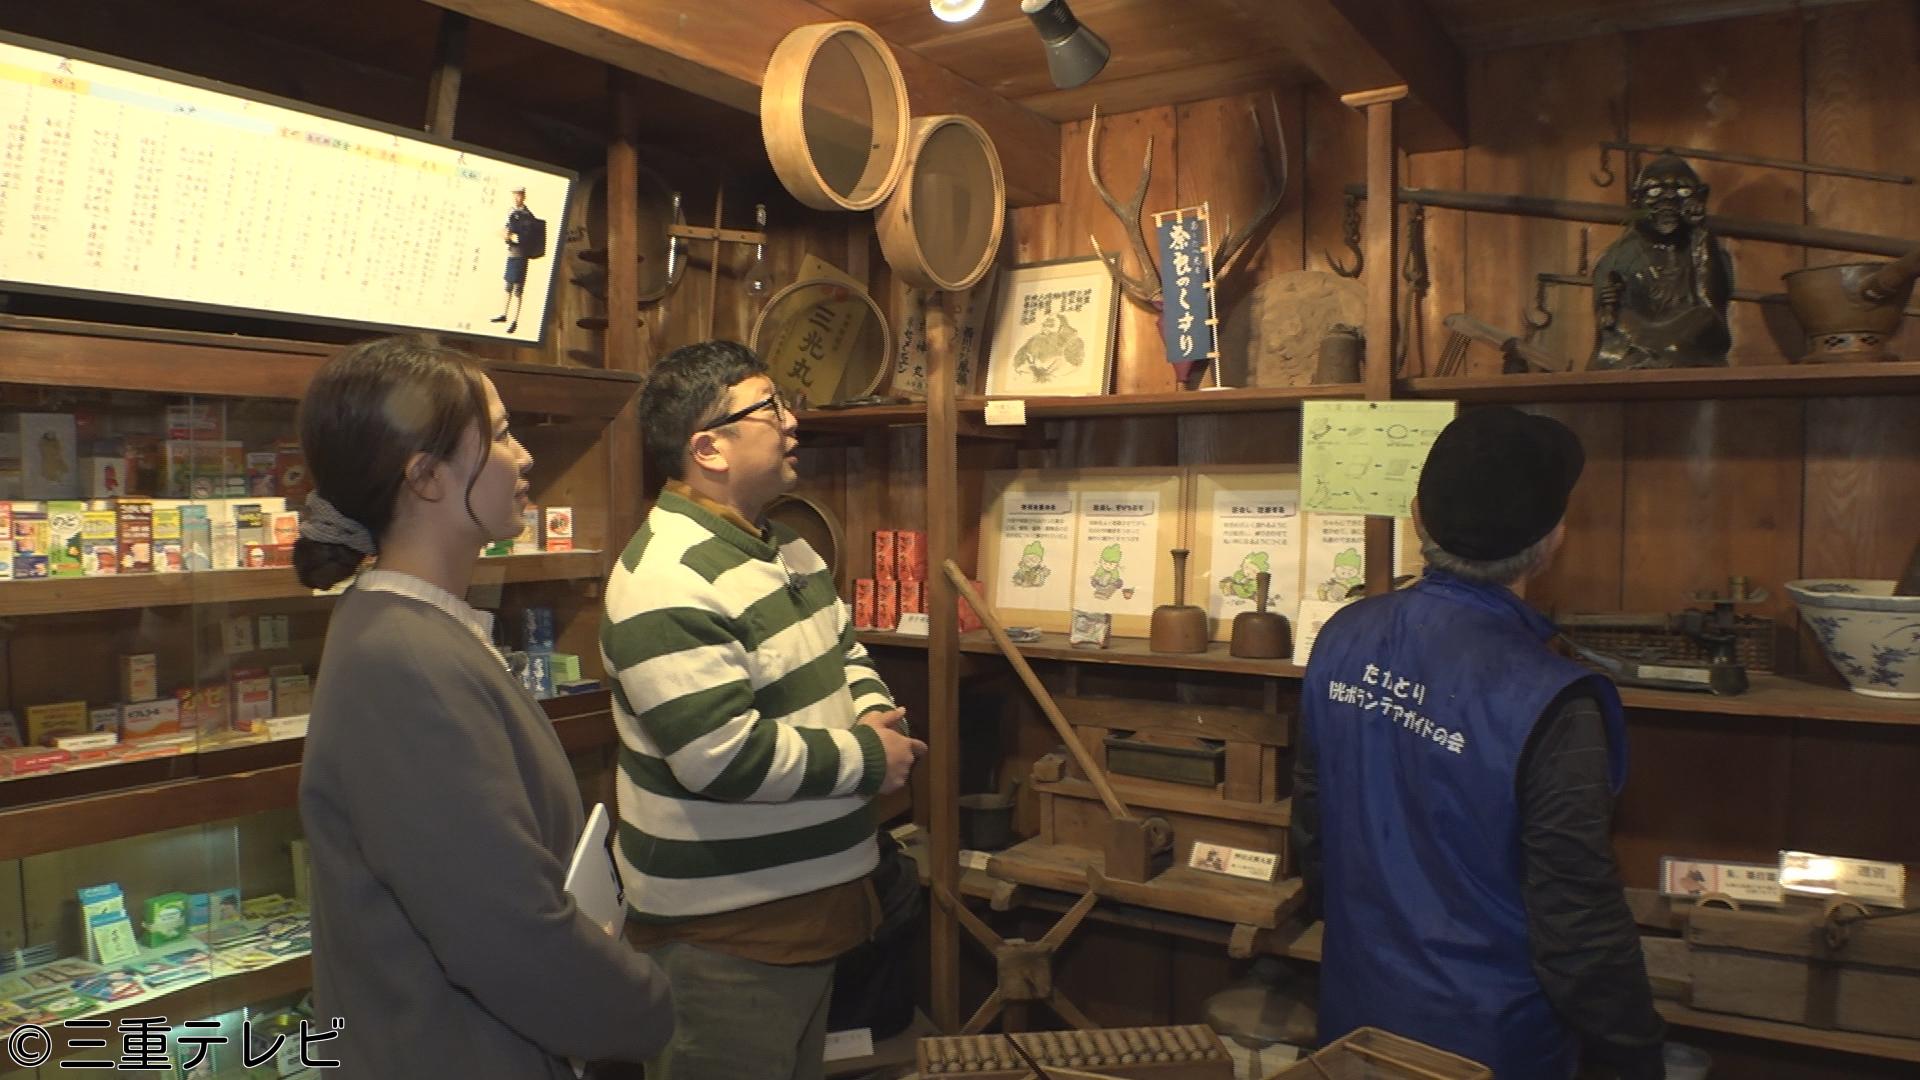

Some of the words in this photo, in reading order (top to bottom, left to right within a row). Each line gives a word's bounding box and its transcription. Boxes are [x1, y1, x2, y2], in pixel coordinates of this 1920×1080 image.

[1169, 225, 1195, 357] 奈良のくすり
[787, 304, 836, 389] 三光丸
